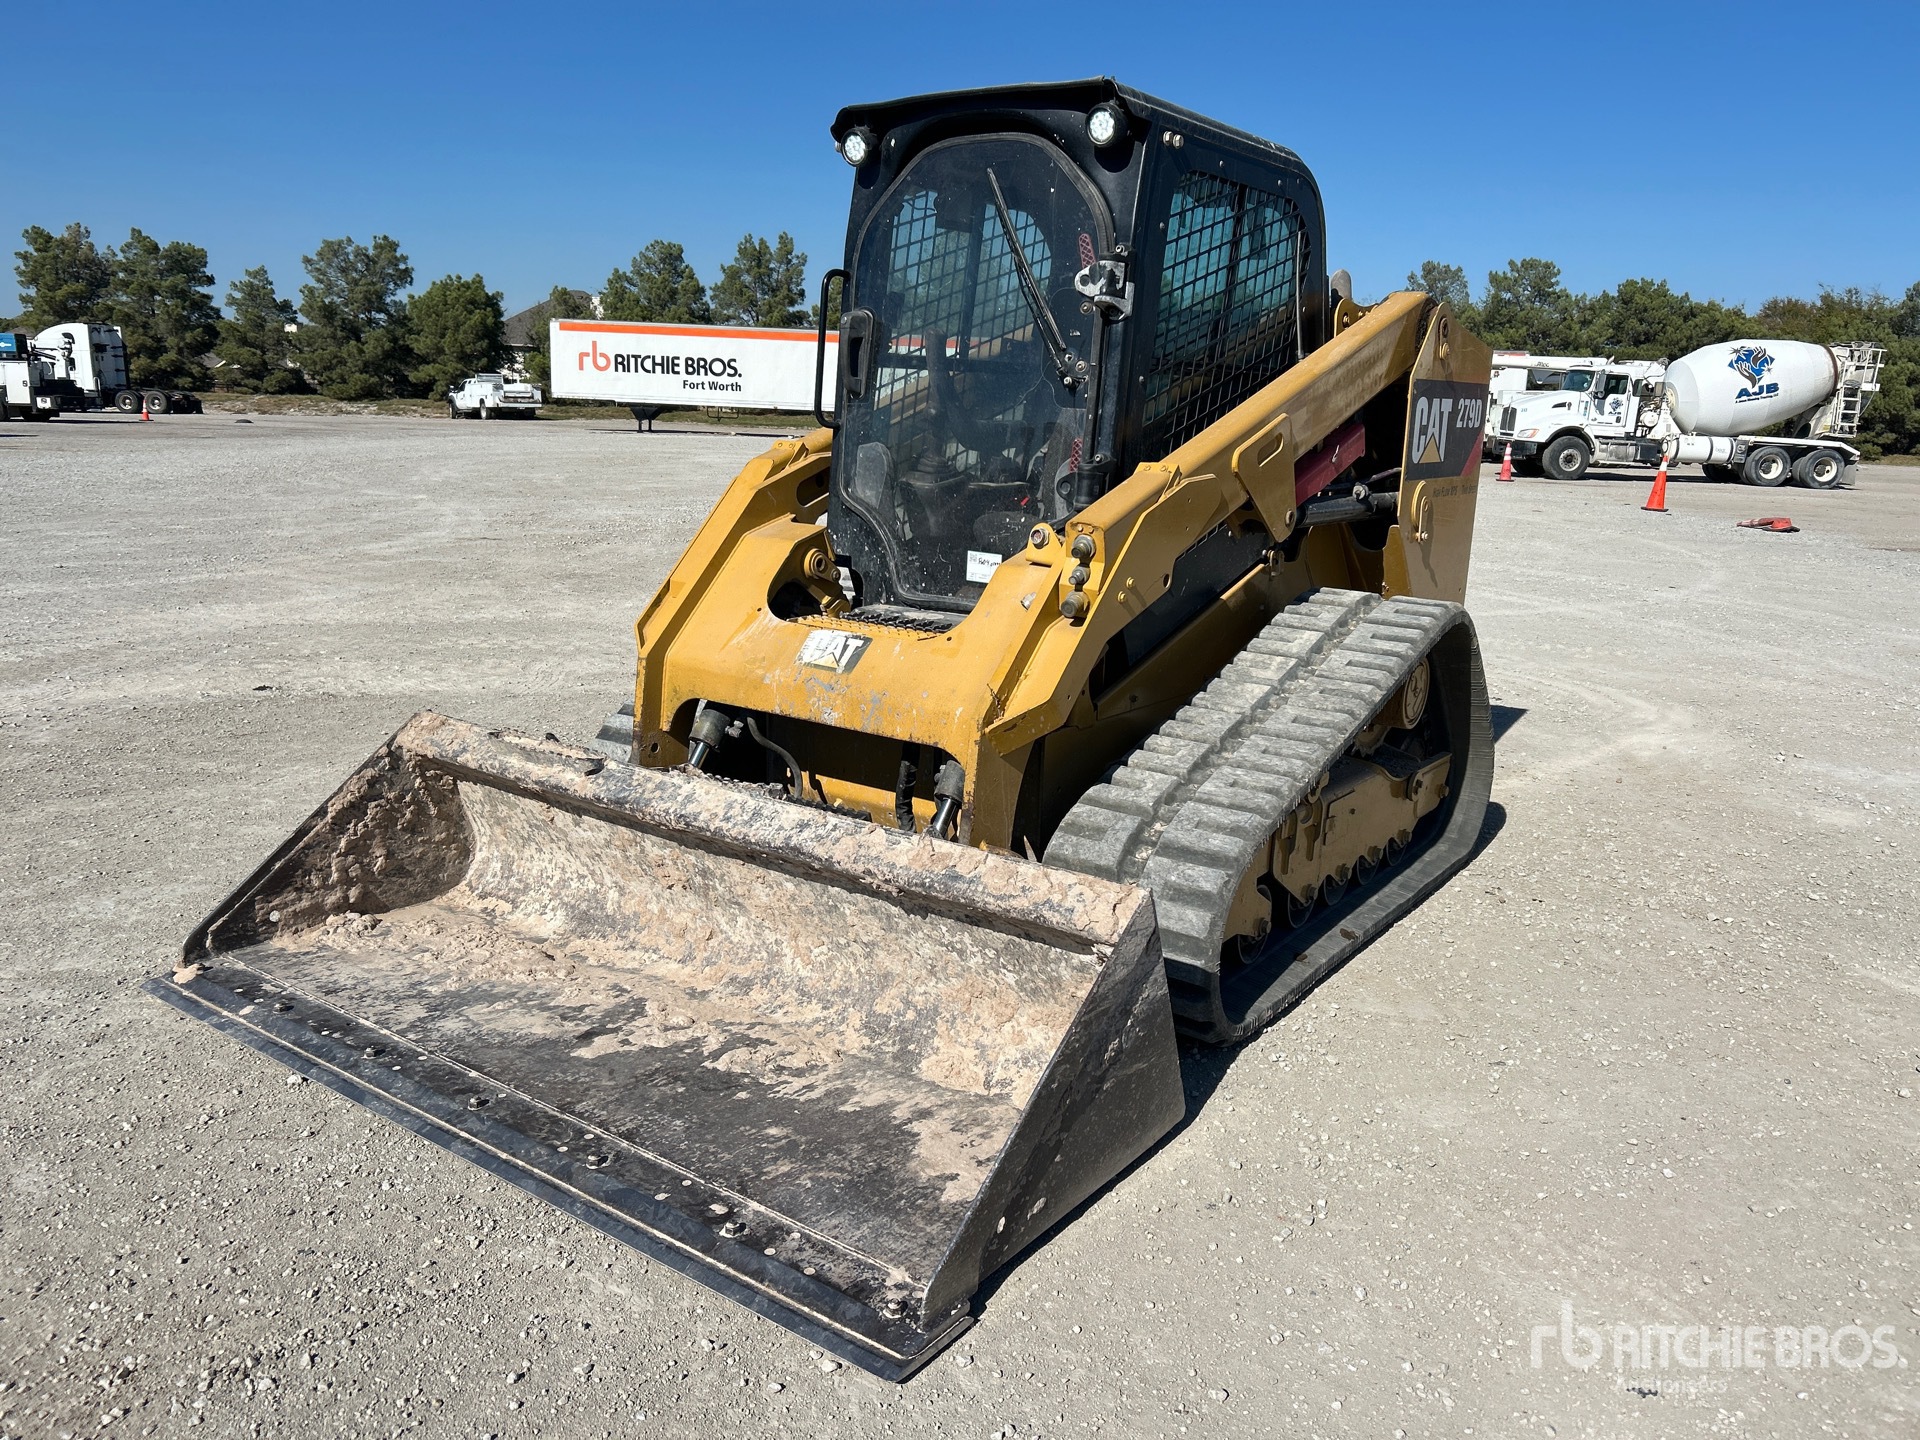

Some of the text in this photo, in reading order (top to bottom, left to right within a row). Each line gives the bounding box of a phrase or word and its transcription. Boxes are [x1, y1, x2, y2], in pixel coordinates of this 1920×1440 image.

[578, 340, 742, 378] rb RITCHIE BROS.
[682, 379, 742, 392] Fort Worth
[1735, 382, 1780, 400] AJB
[1411, 396, 1483, 464] CAT 279D
